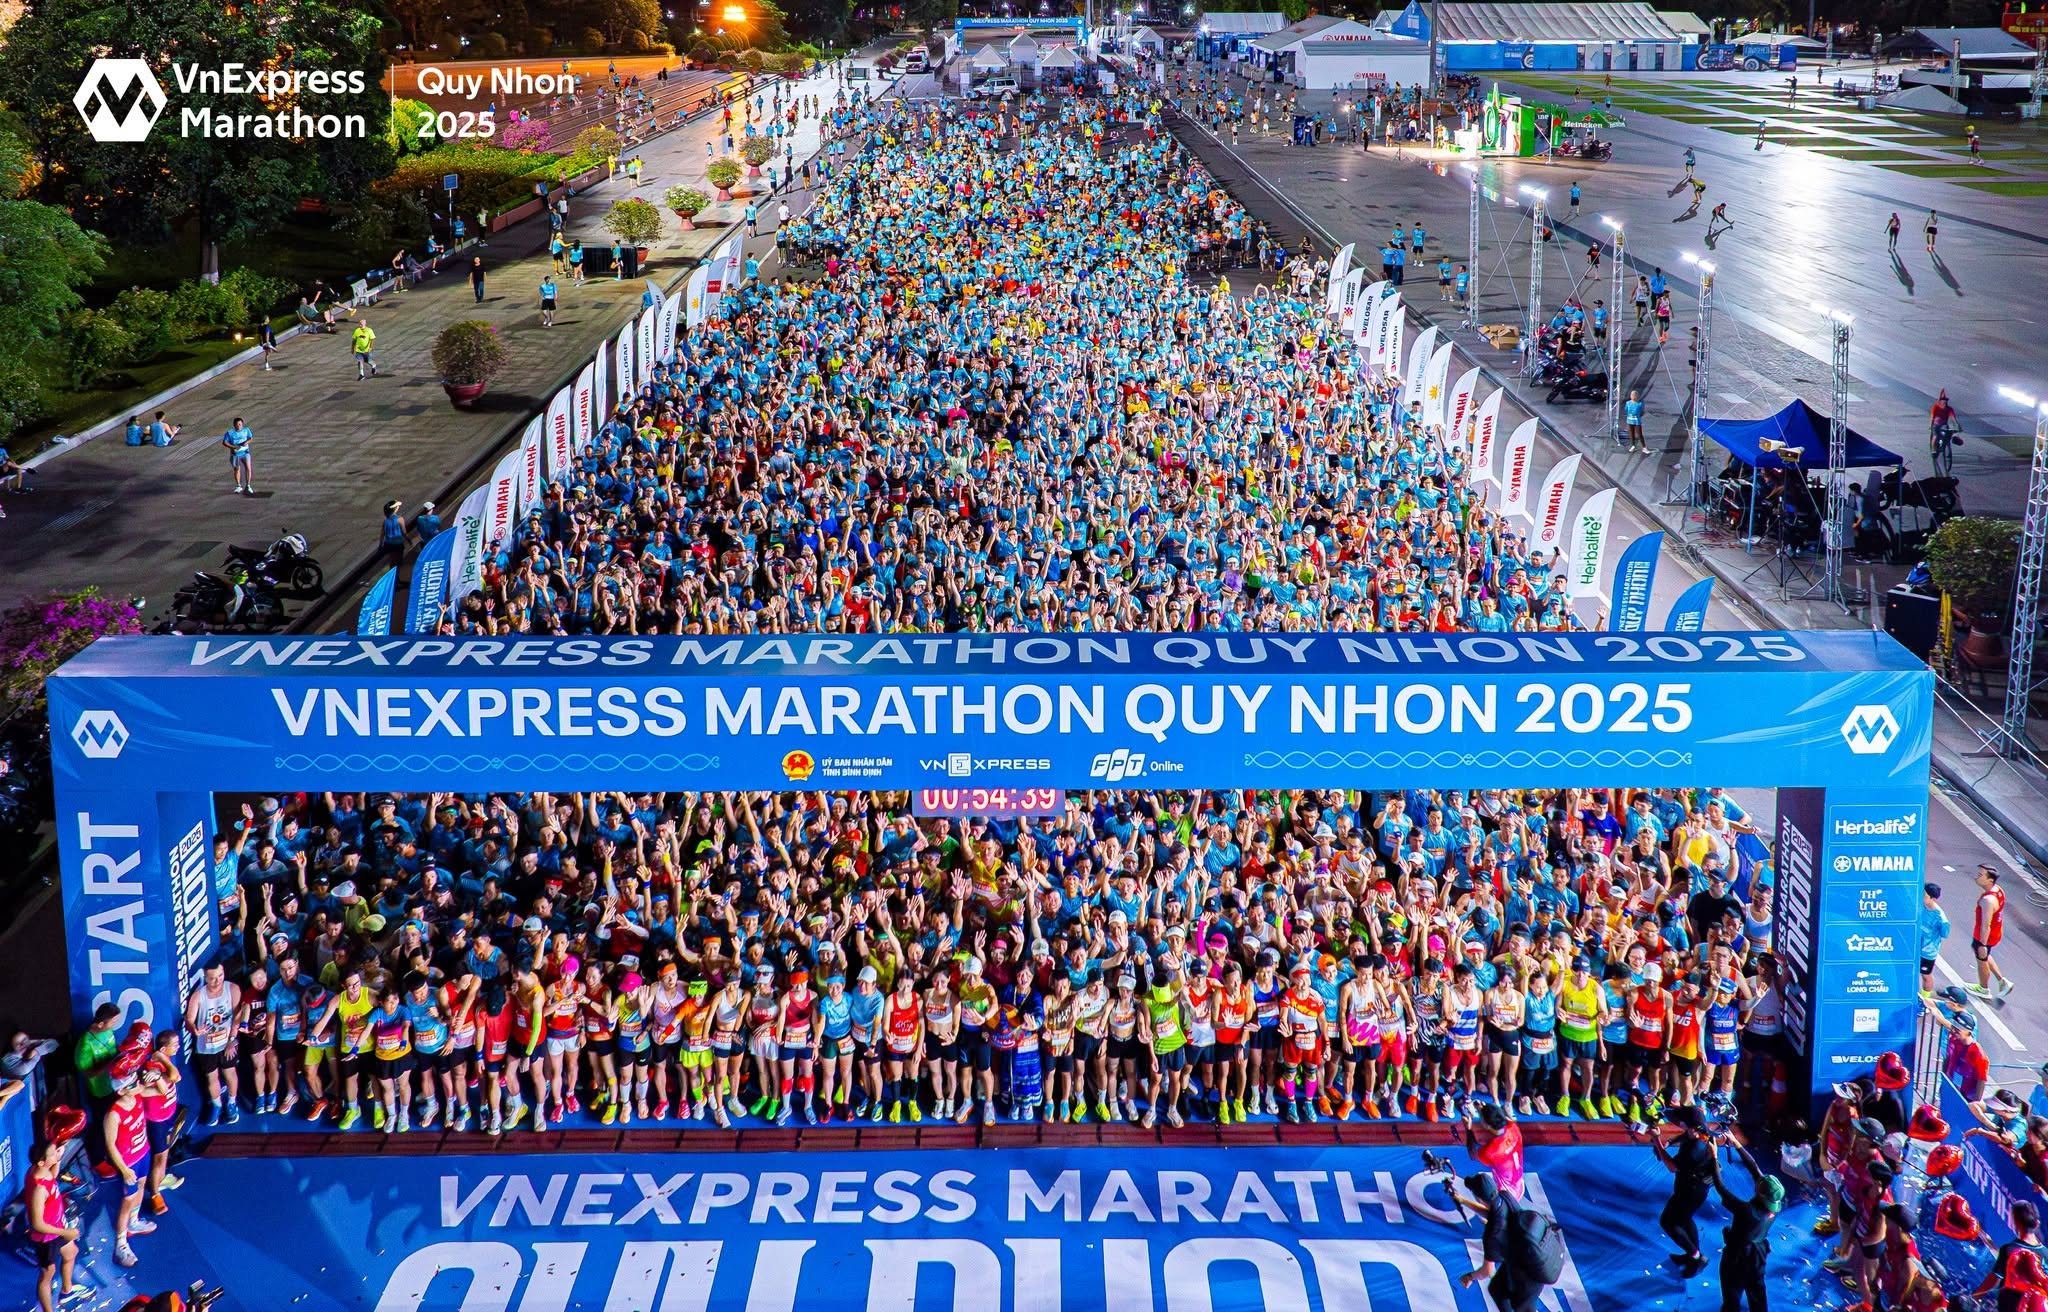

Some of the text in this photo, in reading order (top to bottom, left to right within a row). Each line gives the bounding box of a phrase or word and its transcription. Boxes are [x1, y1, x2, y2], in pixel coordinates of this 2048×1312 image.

[664, 310, 672, 349] VELOSAR
[1362, 296, 1373, 331] VELOSAR
[1379, 310, 1390, 348] VELOSAR
[1391, 326, 1399, 366] VELOSAR
[555, 413, 566, 457] YAMAHA
[1511, 445, 1526, 490] YAMAHA
[495, 478, 510, 527] YAMAHA
[1544, 482, 1565, 528] YAMAHA
[462, 519, 480, 584] Herbalife
[1580, 521, 1602, 585] Herbalife
[189, 636, 1807, 668] VNEXPRESS MARATHON QUY NHON 2025
[271, 683, 1693, 743] VNEXPRESS MARATHON QUY NHON 2025
[834, 759, 851, 767] BAN
[919, 752, 1051, 777] VNEXPRESS
[1090, 748, 1184, 782] FPT Online
[923, 788, 1056, 810] 00:54:39
[181, 822, 203, 860] 2025
[1834, 818, 1910, 835] Herbalife
[1779, 814, 1792, 923] MARATHON
[1851, 855, 1915, 872] YAMAHA
[168, 845, 187, 956] MARATHON
[182, 843, 212, 971] NHON
[1858, 899, 1888, 911] true
[1859, 889, 1877, 900] TH
[78, 812, 154, 1033] START
[1859, 911, 1888, 919] WATER
[1863, 936, 1892, 947] PVI
[1846, 985, 1868, 993] LONG
[439, 1168, 1553, 1228] VNEXPRESS MARATHO
